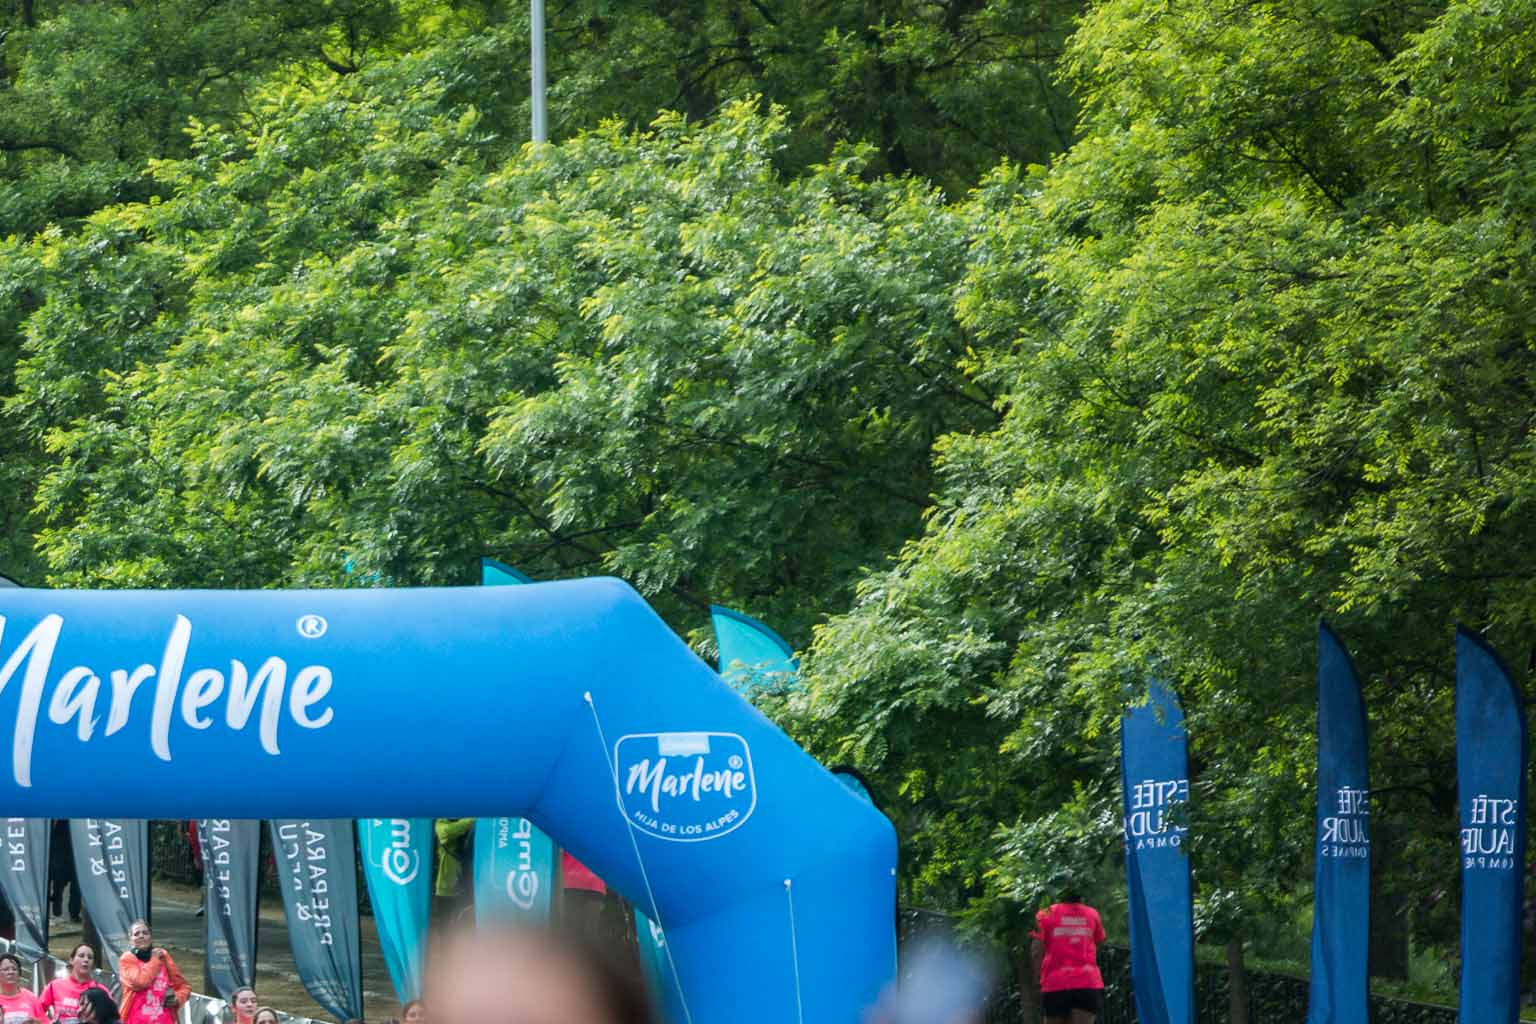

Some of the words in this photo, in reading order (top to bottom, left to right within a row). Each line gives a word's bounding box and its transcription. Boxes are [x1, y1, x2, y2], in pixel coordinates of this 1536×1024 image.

[626, 755, 747, 814] Marlene
[634, 810, 658, 830] HIJA
[661, 823, 676, 834] DE
[680, 824, 703, 835] LOS
[705, 809, 740, 832] ALPES
